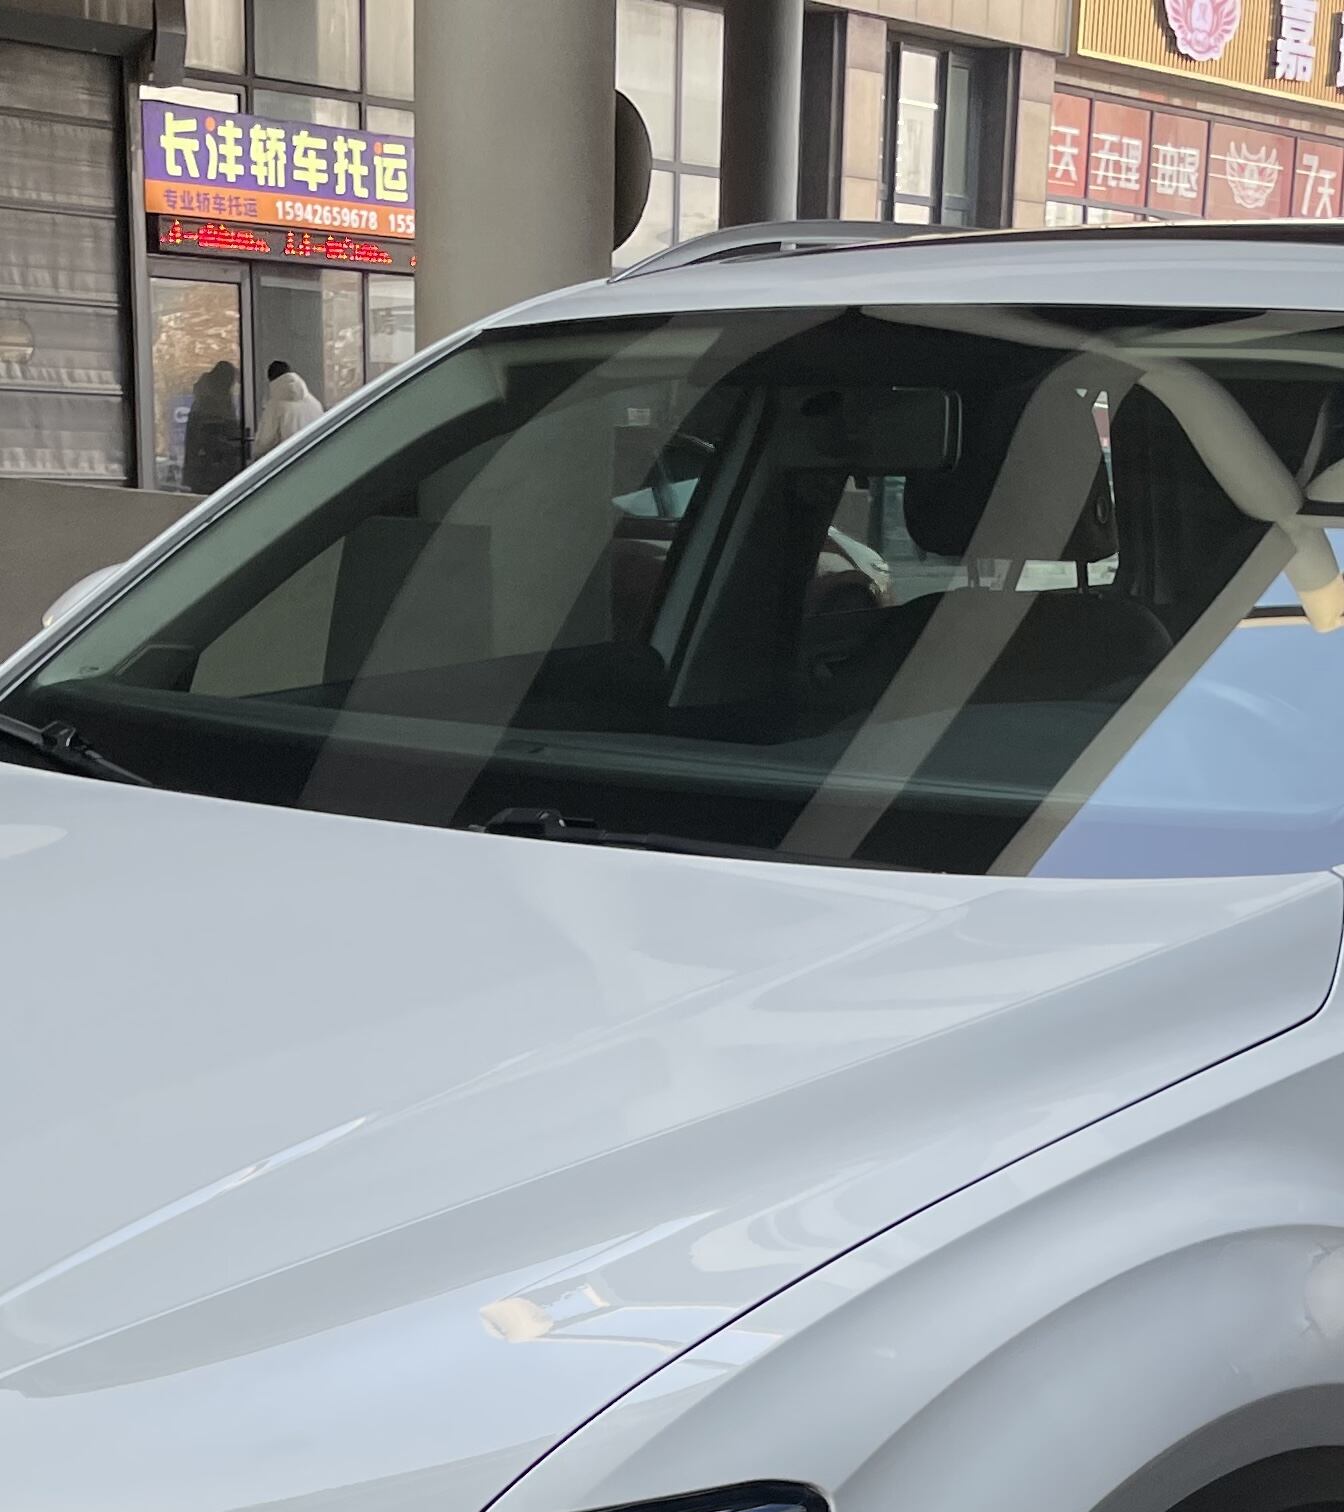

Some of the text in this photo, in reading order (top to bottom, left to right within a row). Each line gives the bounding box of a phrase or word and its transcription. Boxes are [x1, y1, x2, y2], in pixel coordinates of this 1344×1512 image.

[160, 111, 409, 203] 长沣轿车托运
[1049, 122, 1201, 199] 天无理由退
[163, 188, 258, 217] 专业轿车托运
[275, 200, 378, 231] 15942659678
